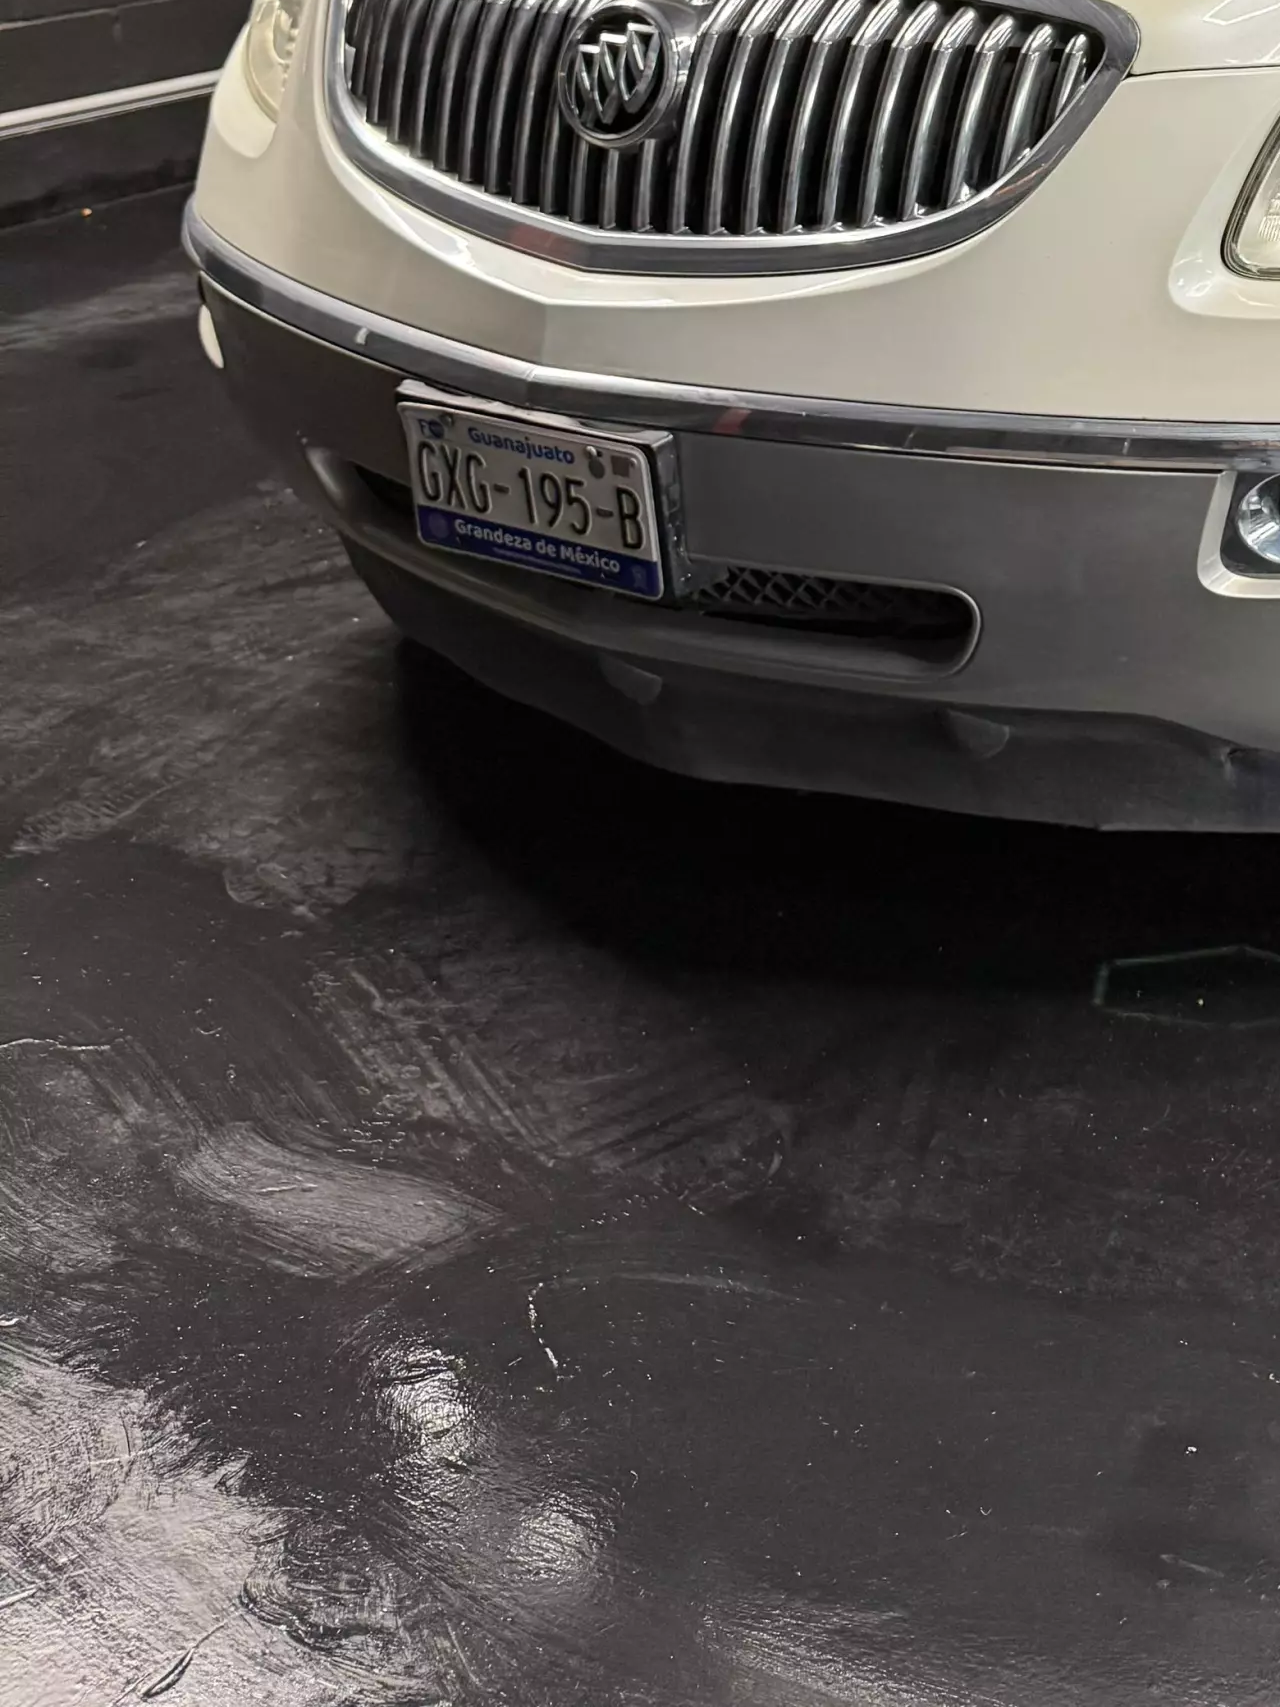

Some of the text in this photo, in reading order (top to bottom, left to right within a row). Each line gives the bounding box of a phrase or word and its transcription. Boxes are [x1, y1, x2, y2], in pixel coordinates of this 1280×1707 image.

[467, 426, 575, 465] Guanajuato
[418, 440, 644, 550] GXG-195-B
[454, 519, 532, 551] Grandeza
[536, 536, 557, 558] de
[559, 543, 621, 573] México
